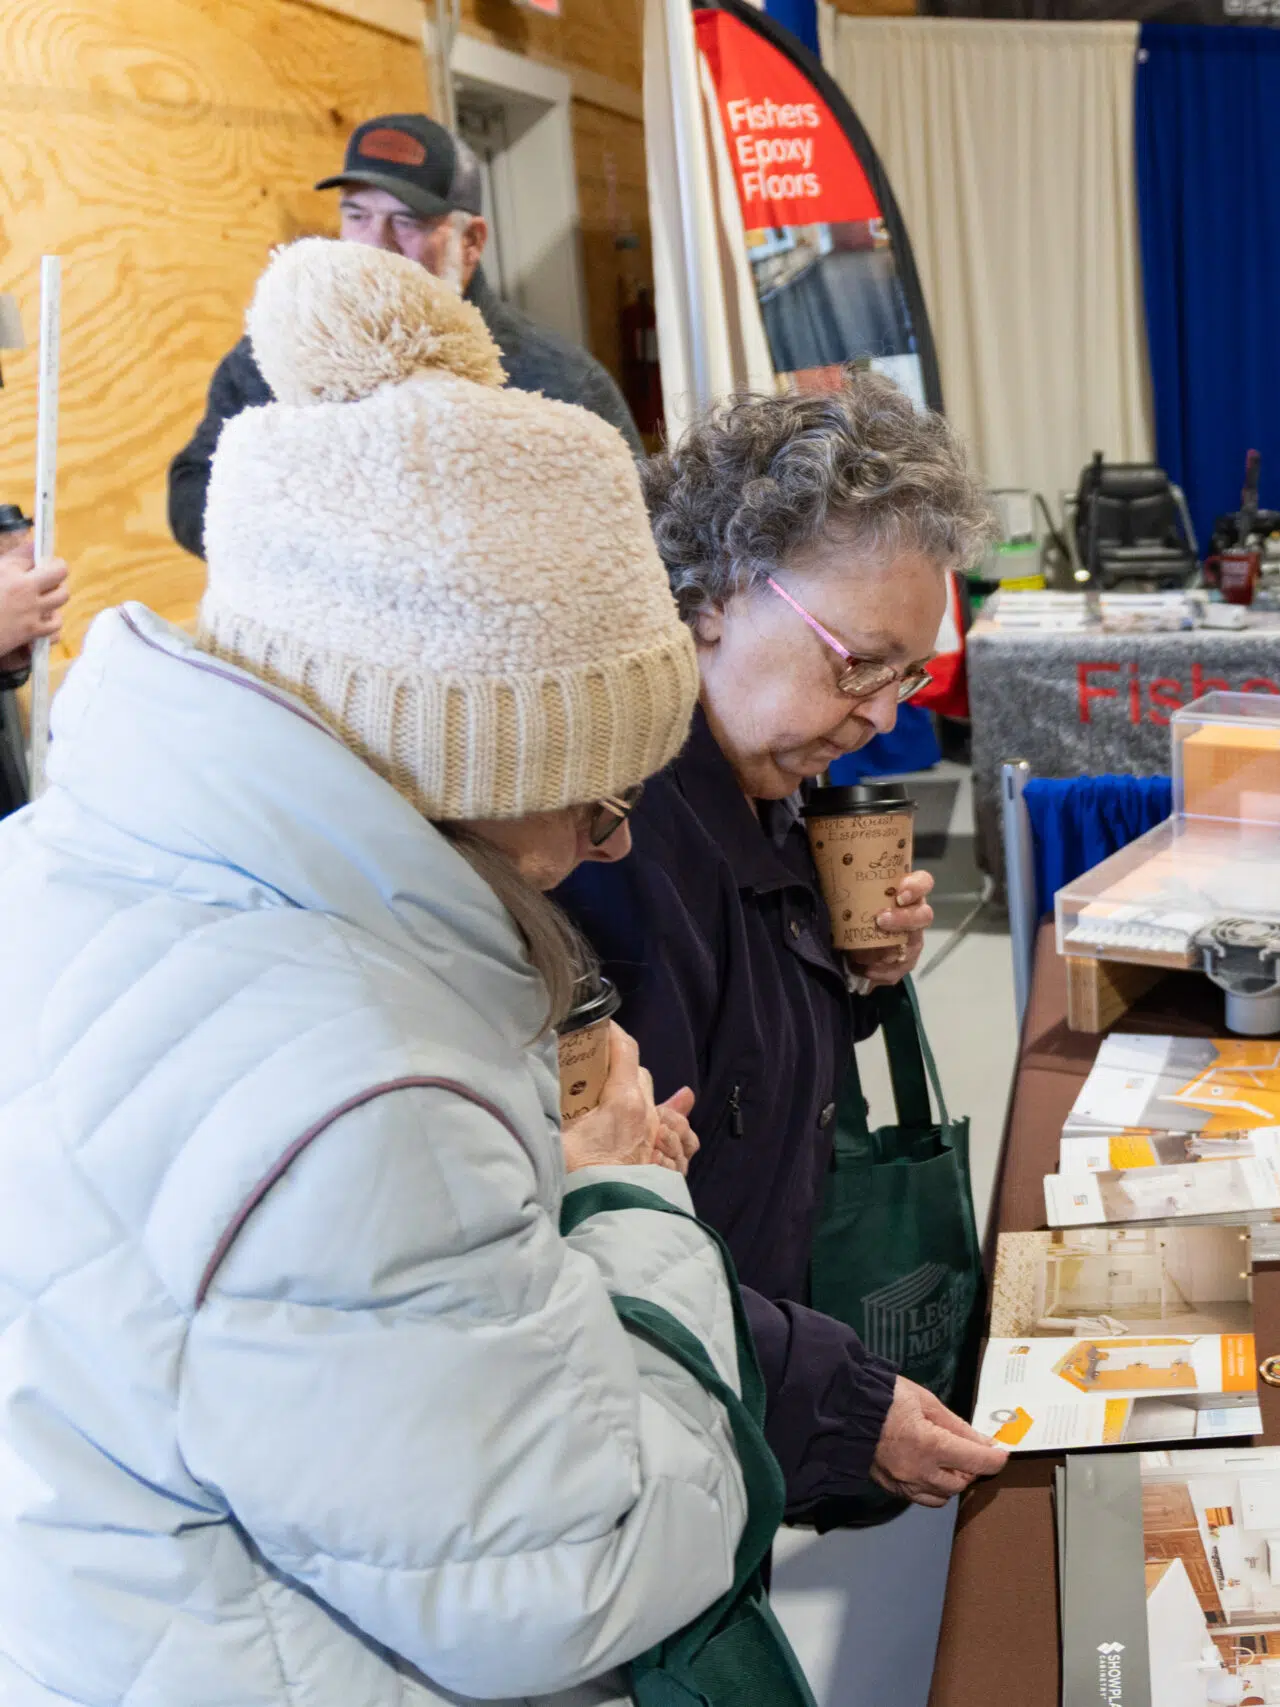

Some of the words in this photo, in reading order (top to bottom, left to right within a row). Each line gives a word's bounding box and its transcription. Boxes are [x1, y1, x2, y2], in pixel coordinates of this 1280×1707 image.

[726, 97, 821, 131] Fishers
[735, 135, 813, 169] Epoxy
[742, 171, 822, 202] Floors
[827, 827, 899, 842] Espresso
[855, 869, 897, 881] BOLD
